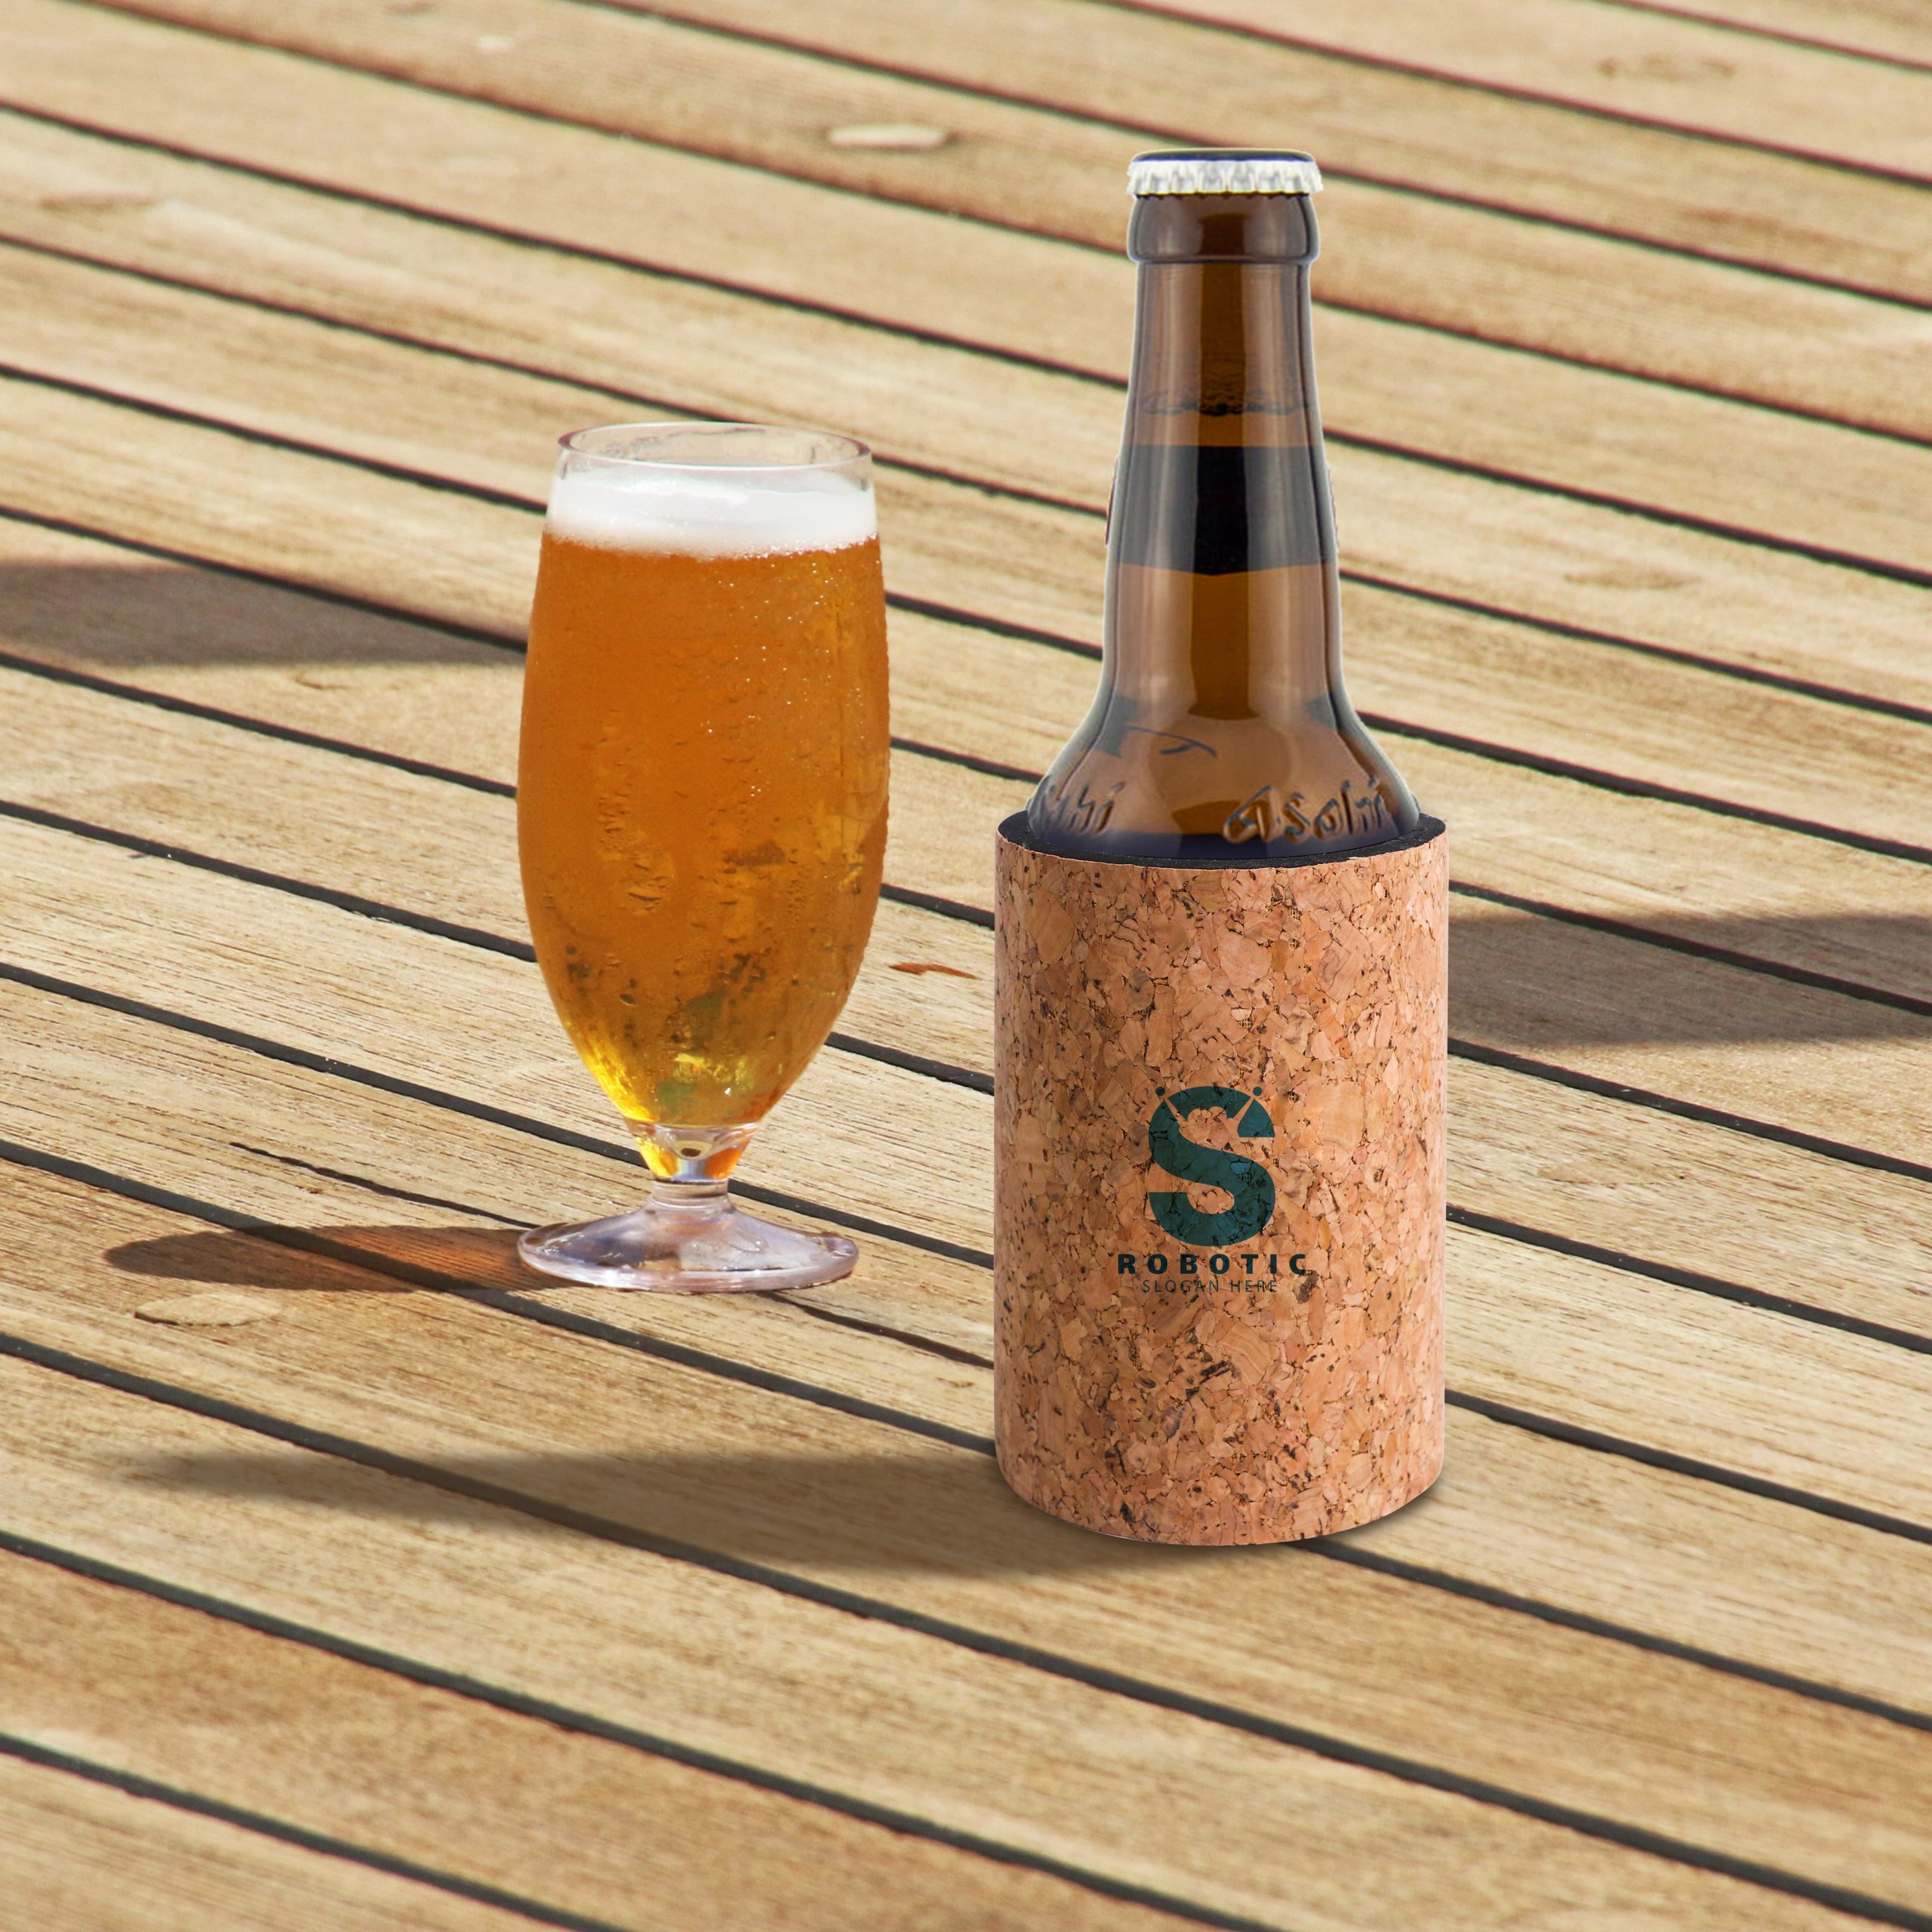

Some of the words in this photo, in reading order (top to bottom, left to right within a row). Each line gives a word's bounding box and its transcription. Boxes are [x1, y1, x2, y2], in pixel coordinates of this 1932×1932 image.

[1149, 1086, 1275, 1246] S
[1118, 1254, 1306, 1275] ROBOTIC
[1143, 1280, 1219, 1293] SLOGAN
[1231, 1280, 1278, 1292] HERE
